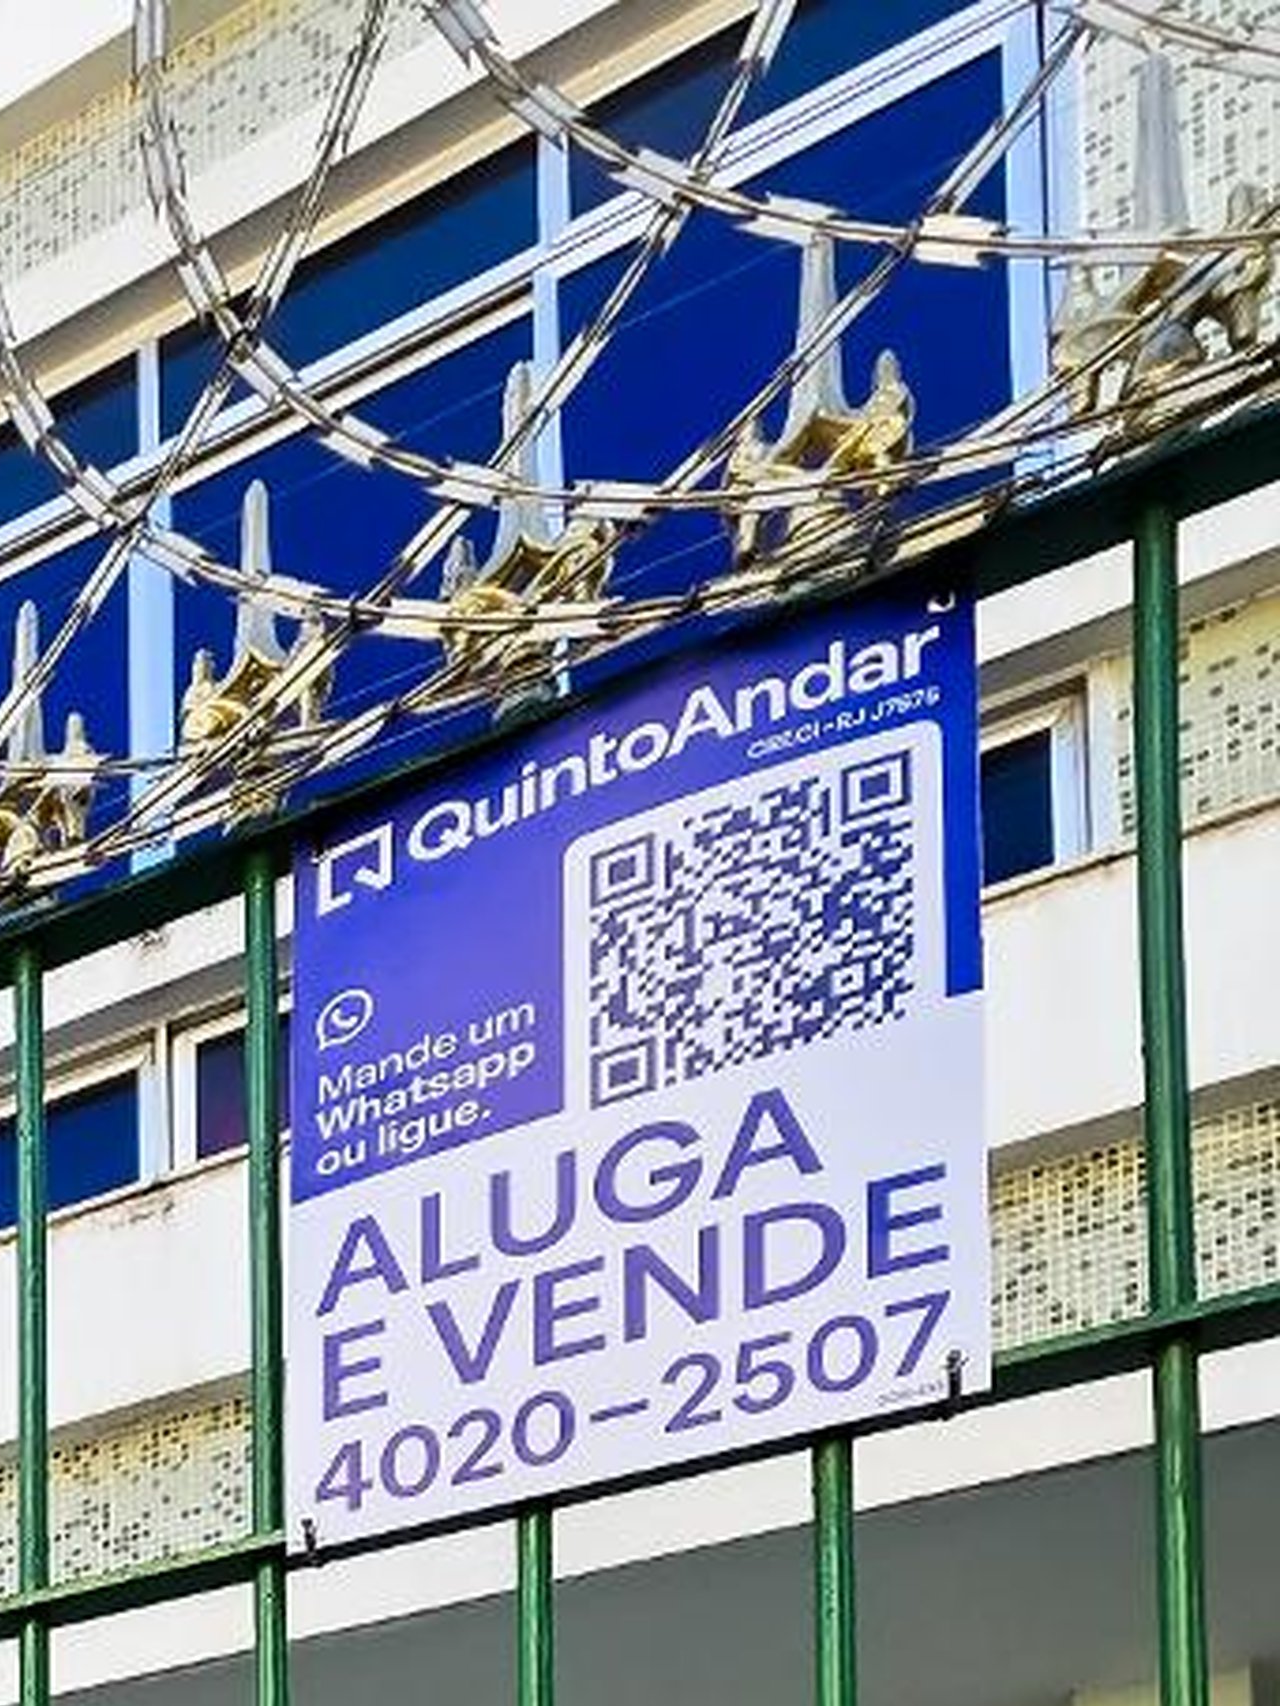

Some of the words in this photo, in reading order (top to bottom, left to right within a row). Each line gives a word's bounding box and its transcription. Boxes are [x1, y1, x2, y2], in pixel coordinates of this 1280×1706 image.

[404, 626, 941, 864] QuintoAndar
[315, 1042, 536, 1140] Whatsapp
[316, 1139, 366, 1176] ou
[378, 1100, 491, 1156] ligue.
[317, 1033, 458, 1104] Mande
[469, 1003, 536, 1045] um
[314, 1087, 825, 1317] ALUGA
[322, 1317, 390, 1421] E
[426, 1162, 950, 1387] VENDE
[313, 1288, 952, 1511] 4020-2507
